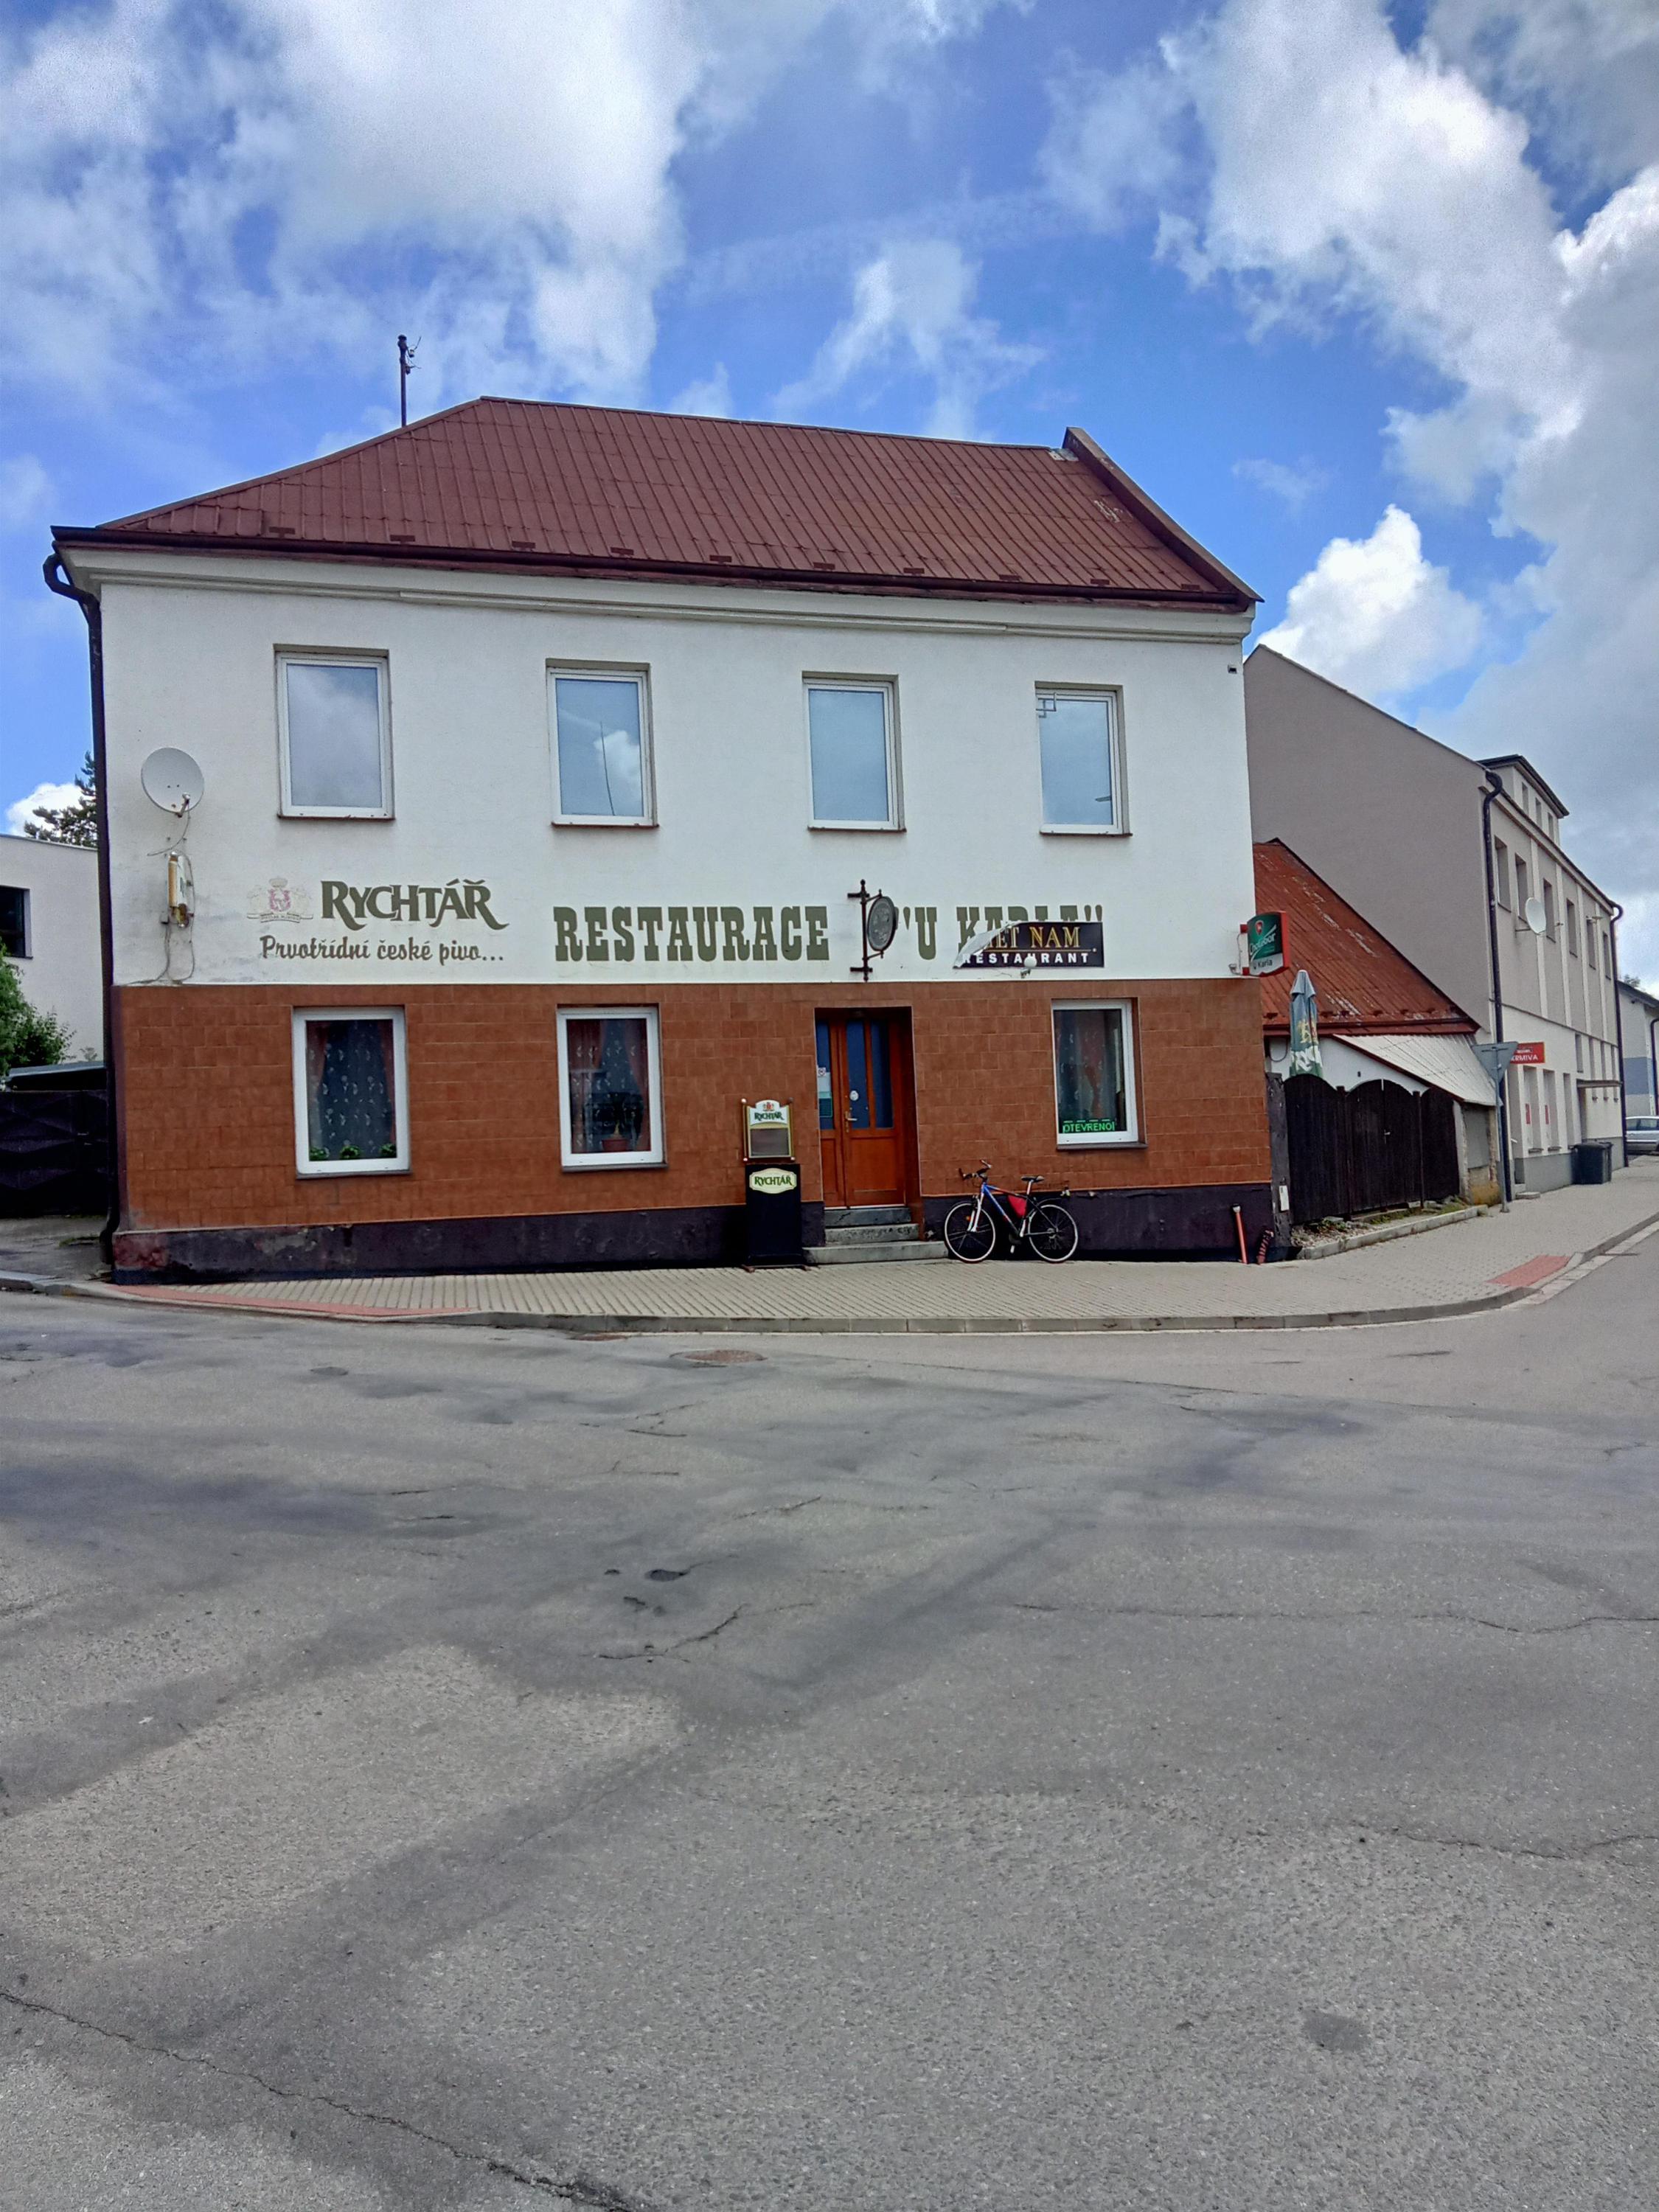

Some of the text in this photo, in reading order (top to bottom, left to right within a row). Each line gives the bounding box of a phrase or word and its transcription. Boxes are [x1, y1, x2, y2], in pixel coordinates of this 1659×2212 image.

[321, 878, 509, 931] RYCHTÁŘ
[260, 935, 370, 959] Prvotřídní
[377, 936, 433, 960] české
[553, 906, 830, 961] RESTAURACE
[1029, 926, 1080, 948] NAM
